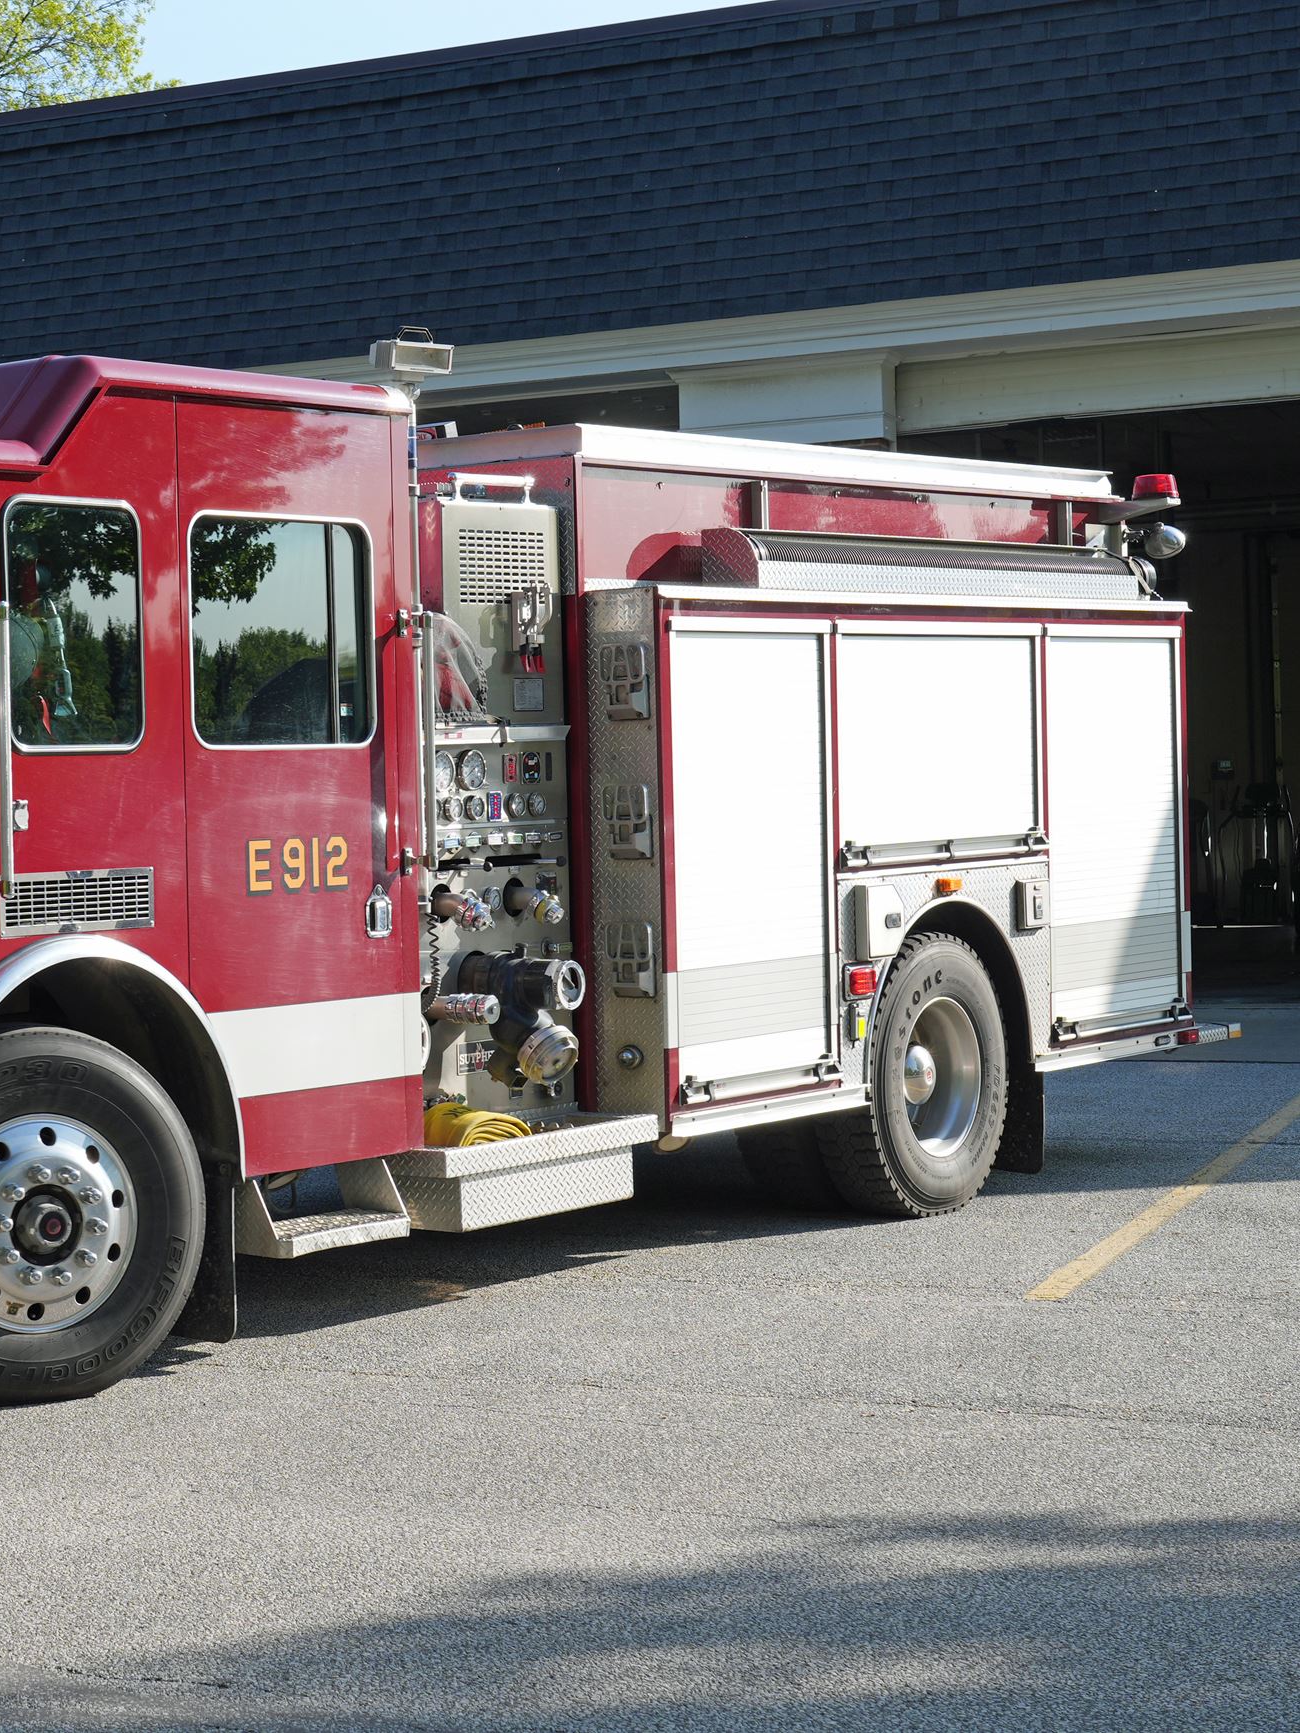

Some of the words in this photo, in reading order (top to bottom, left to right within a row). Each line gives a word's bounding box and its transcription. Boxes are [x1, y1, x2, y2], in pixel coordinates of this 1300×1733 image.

[248, 839, 273, 894] E
[281, 836, 349, 892] 912
[459, 1050, 495, 1065] SUTPHE
